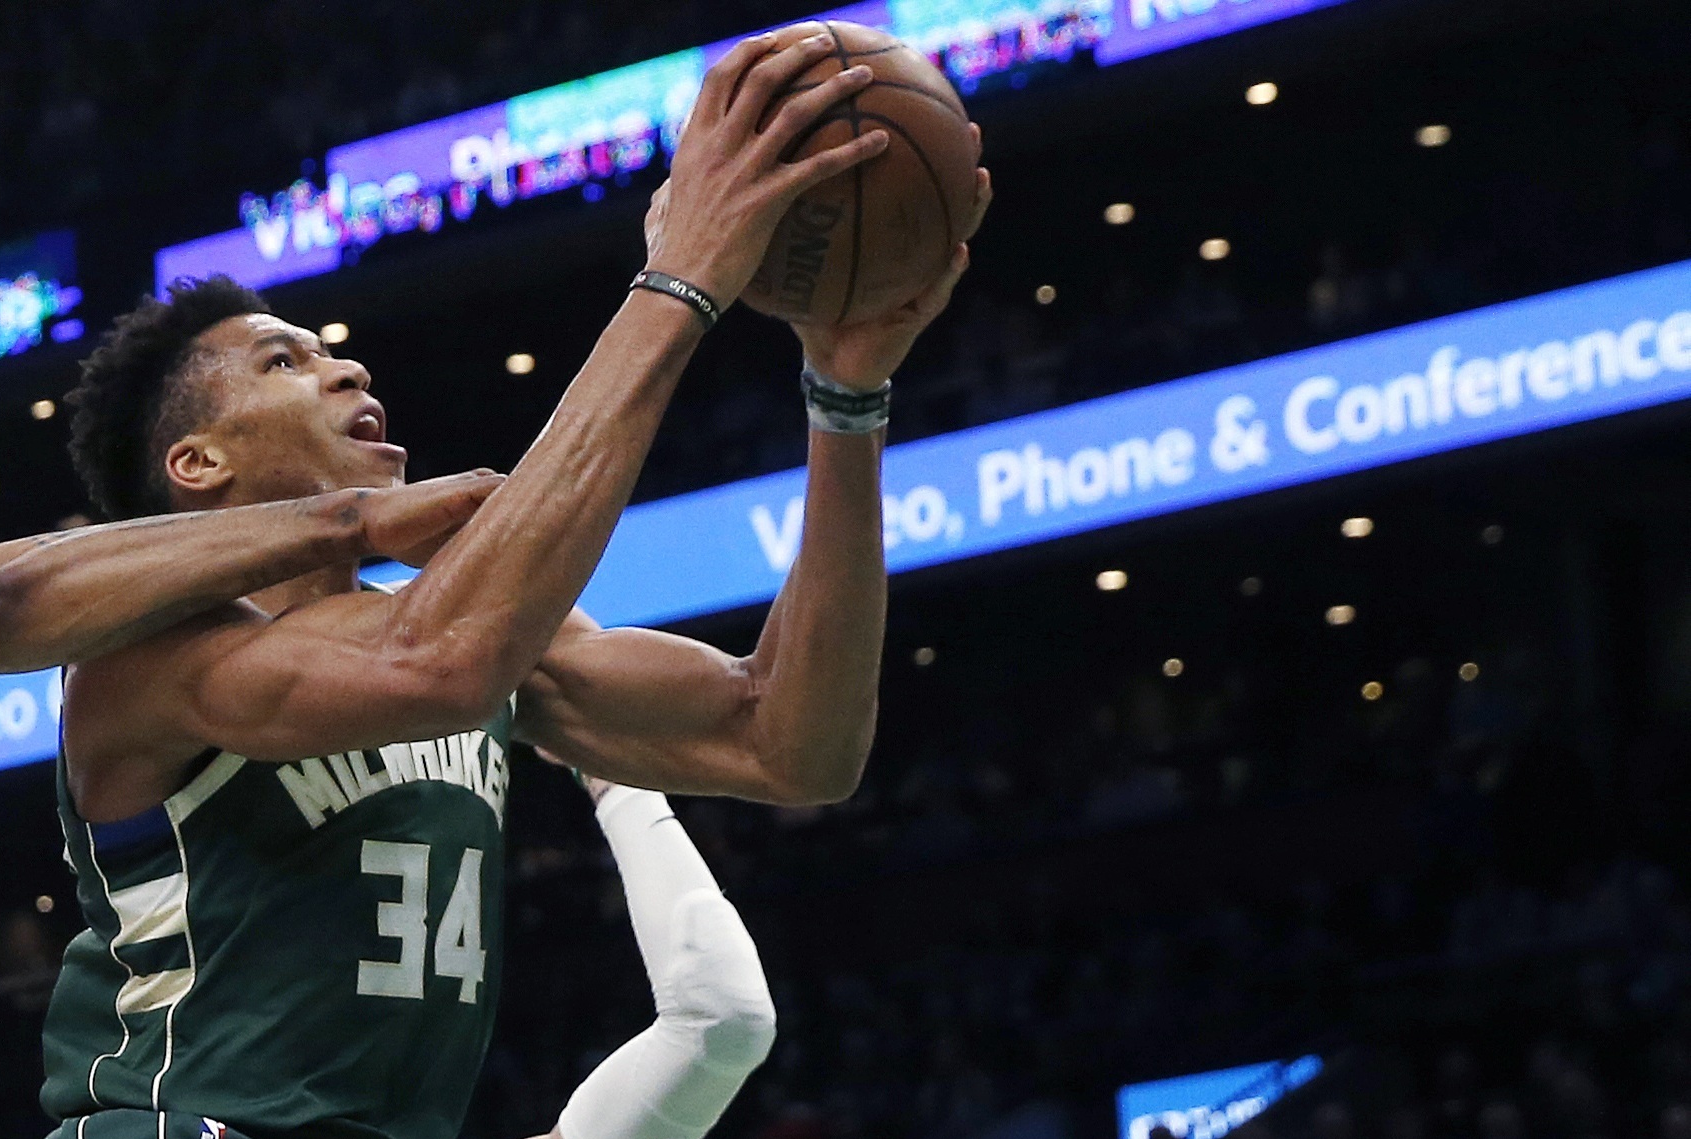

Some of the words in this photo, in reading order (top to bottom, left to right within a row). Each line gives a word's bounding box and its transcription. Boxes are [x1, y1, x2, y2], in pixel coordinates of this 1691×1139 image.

[976, 427, 1197, 528] Phone
[1212, 394, 1269, 474] &
[1283, 311, 1691, 455] Conference
[356, 839, 487, 1005] 34
